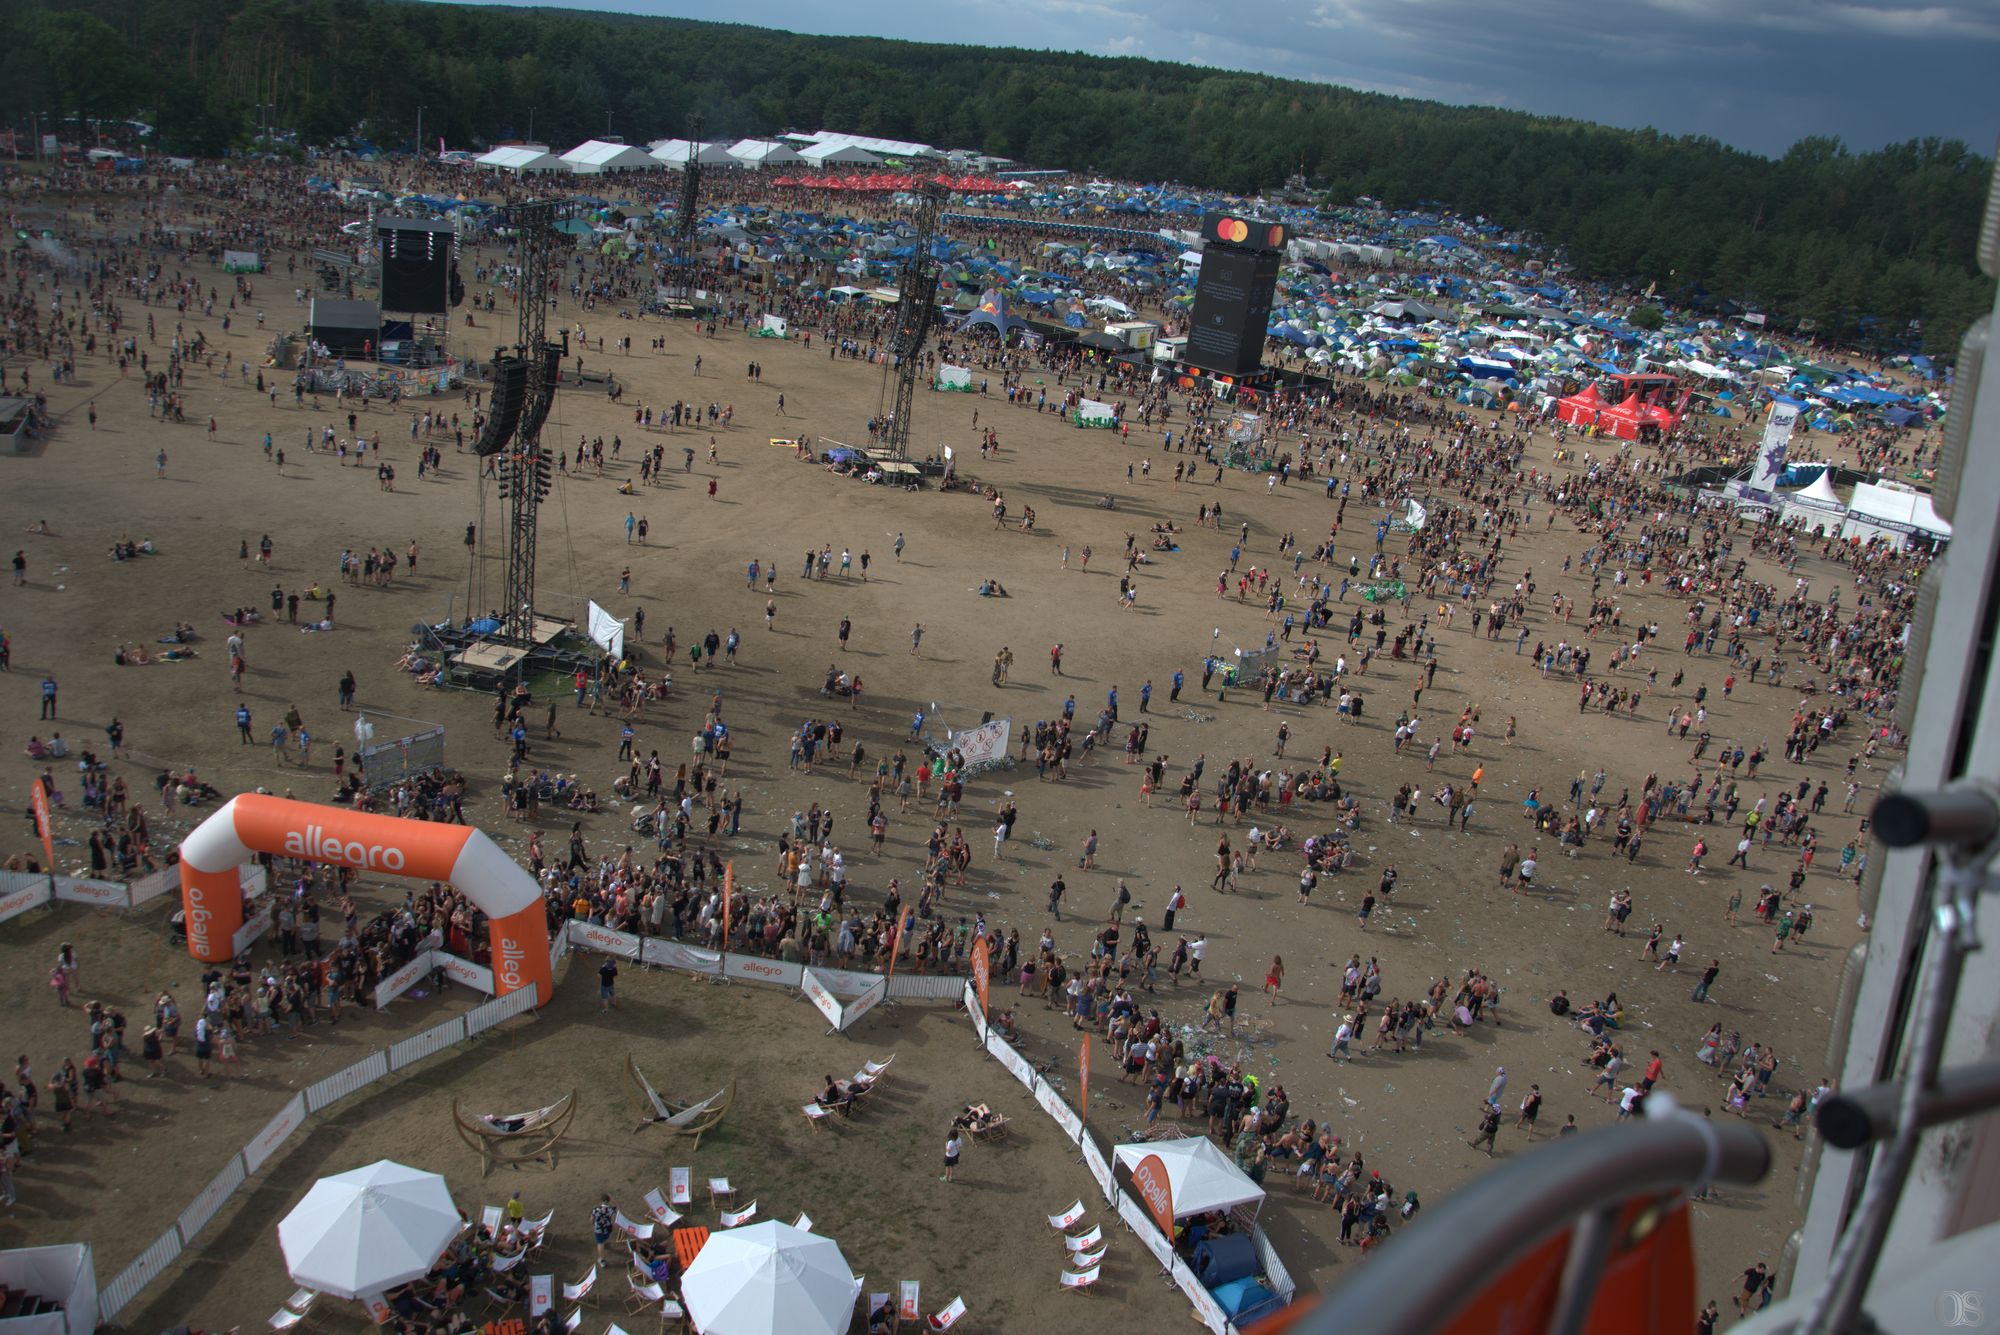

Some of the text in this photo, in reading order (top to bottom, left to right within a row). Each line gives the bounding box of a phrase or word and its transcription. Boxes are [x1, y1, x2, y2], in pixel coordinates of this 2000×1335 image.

[284, 824, 405, 871] allegro
[73, 884, 110, 898] allegro
[189, 887, 212, 957] allegro
[586, 929, 622, 947] allegro
[743, 961, 783, 977] allegro
[811, 983, 832, 1011] allegro
